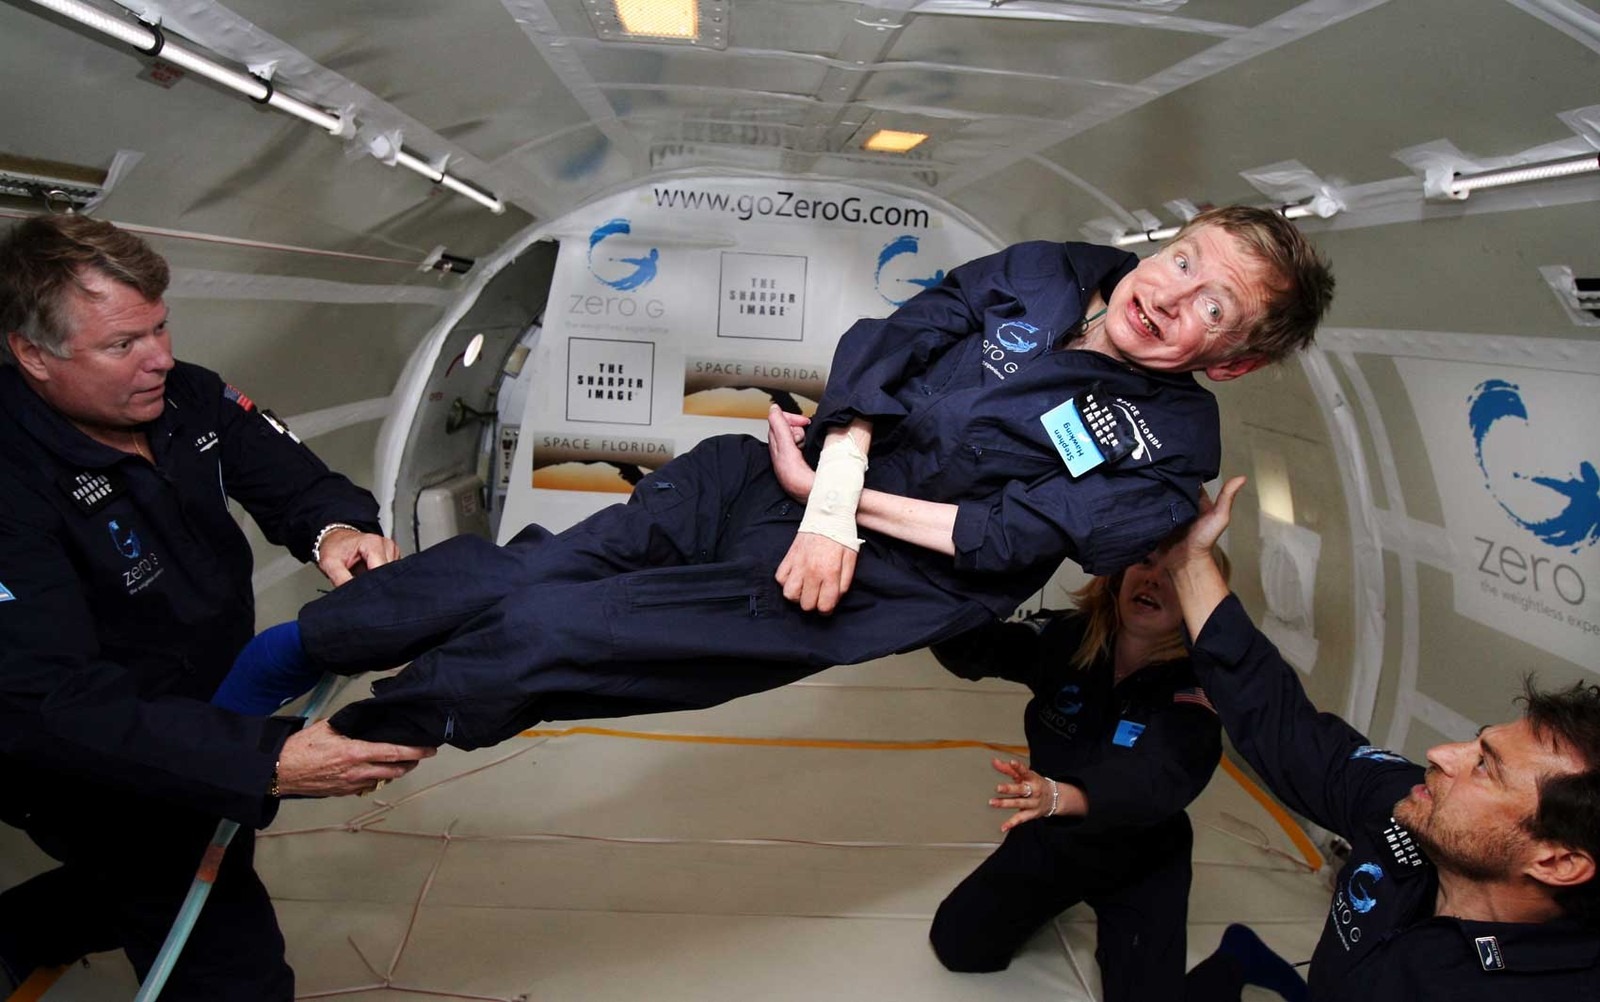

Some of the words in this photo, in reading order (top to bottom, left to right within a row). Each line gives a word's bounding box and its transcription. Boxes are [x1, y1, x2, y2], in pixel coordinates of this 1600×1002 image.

[654, 188, 929, 228] www.goZeroG.com
[751, 278, 776, 289] THE
[569, 294, 637, 317] zero
[645, 299, 664, 318] G
[729, 290, 795, 303] SHARPER
[739, 304, 785, 316] IMAGE
[599, 363, 624, 374] THE
[696, 361, 742, 375] SPACE
[754, 365, 819, 380] FLORIDA
[1004, 362, 1018, 374] G
[577, 375, 643, 388] SHARPER
[588, 389, 632, 401] IMAGE
[1083, 407, 1108, 445] IMAGE
[1086, 394, 1119, 447] SHARPER
[1101, 406, 1117, 428] THE
[543, 436, 590, 450] SPACE
[601, 440, 668, 453] FLORIDA
[1063, 421, 1085, 457] Hawking
[1138, 419, 1162, 449] FLORIDA
[1054, 429, 1075, 462] Stephen
[1475, 537, 1586, 605] zero
[1383, 828, 1408, 864] IMAGE
